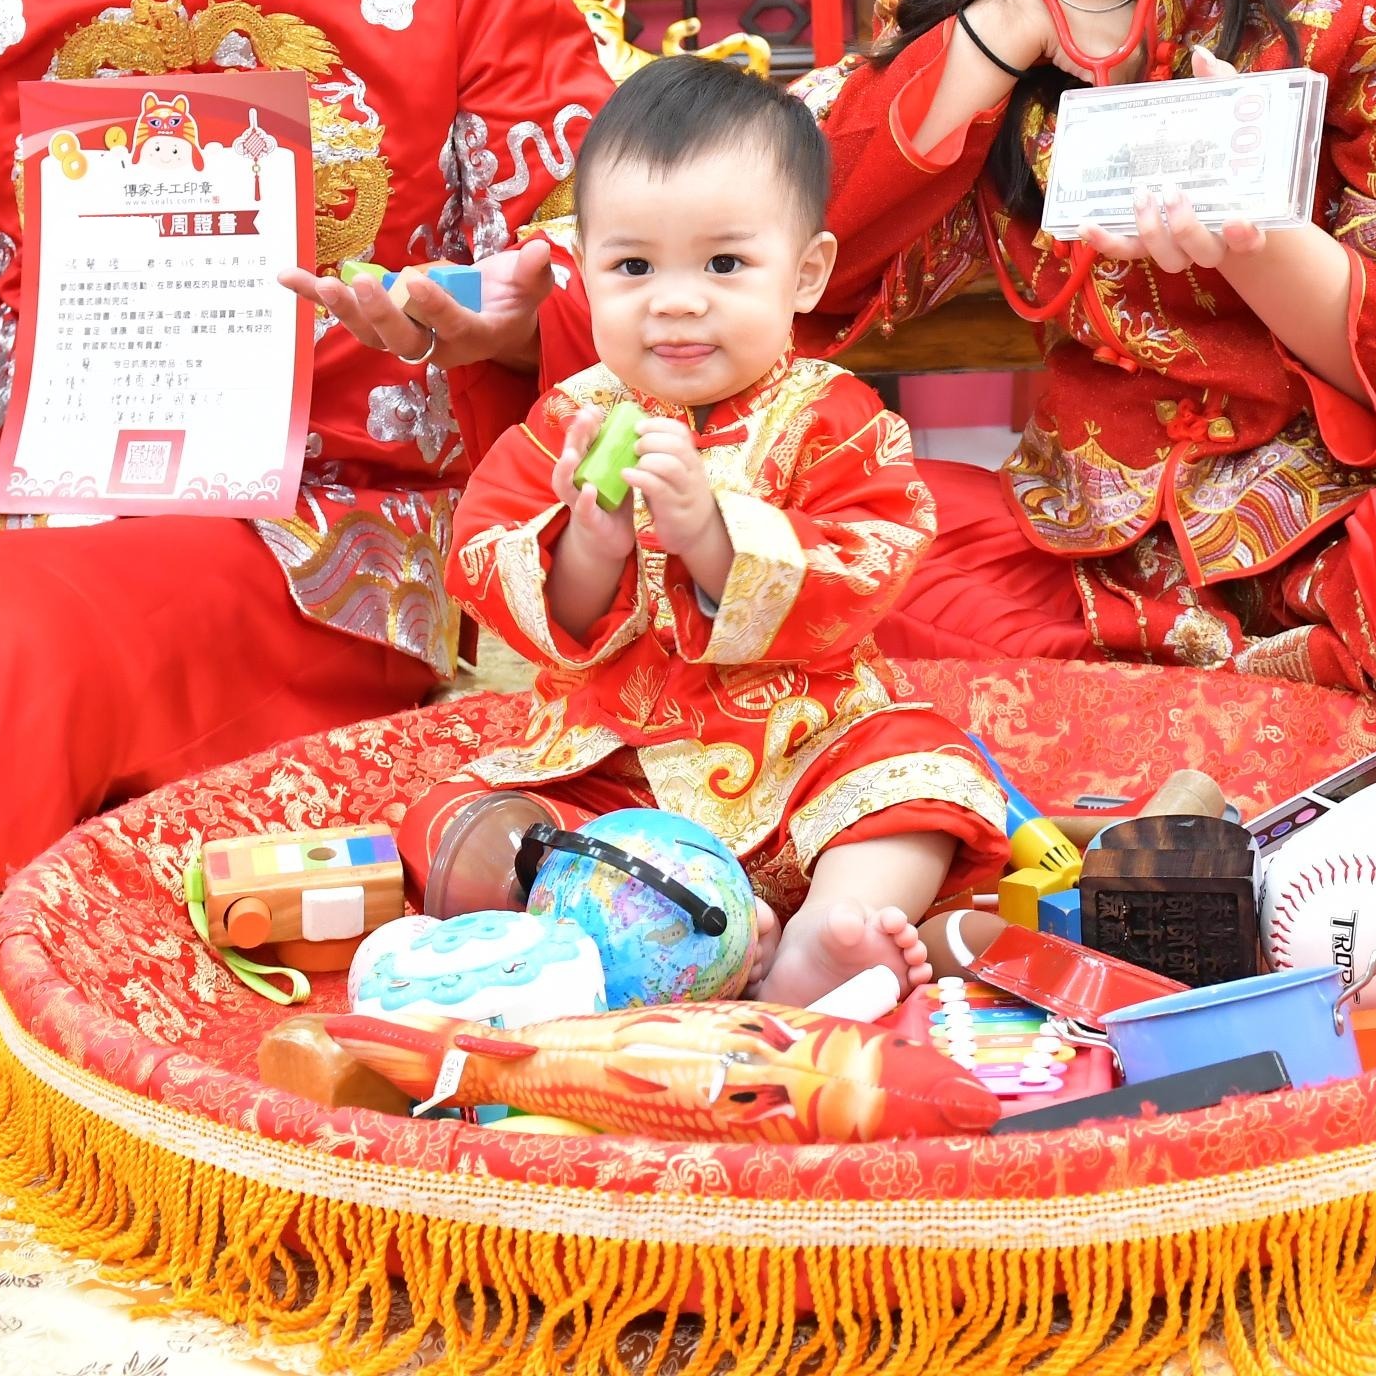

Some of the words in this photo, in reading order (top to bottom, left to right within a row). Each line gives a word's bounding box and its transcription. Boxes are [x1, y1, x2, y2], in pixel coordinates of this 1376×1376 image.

[124, 181, 213, 197] 傳家手工印章
[1330, 910, 1361, 1004] TROP
